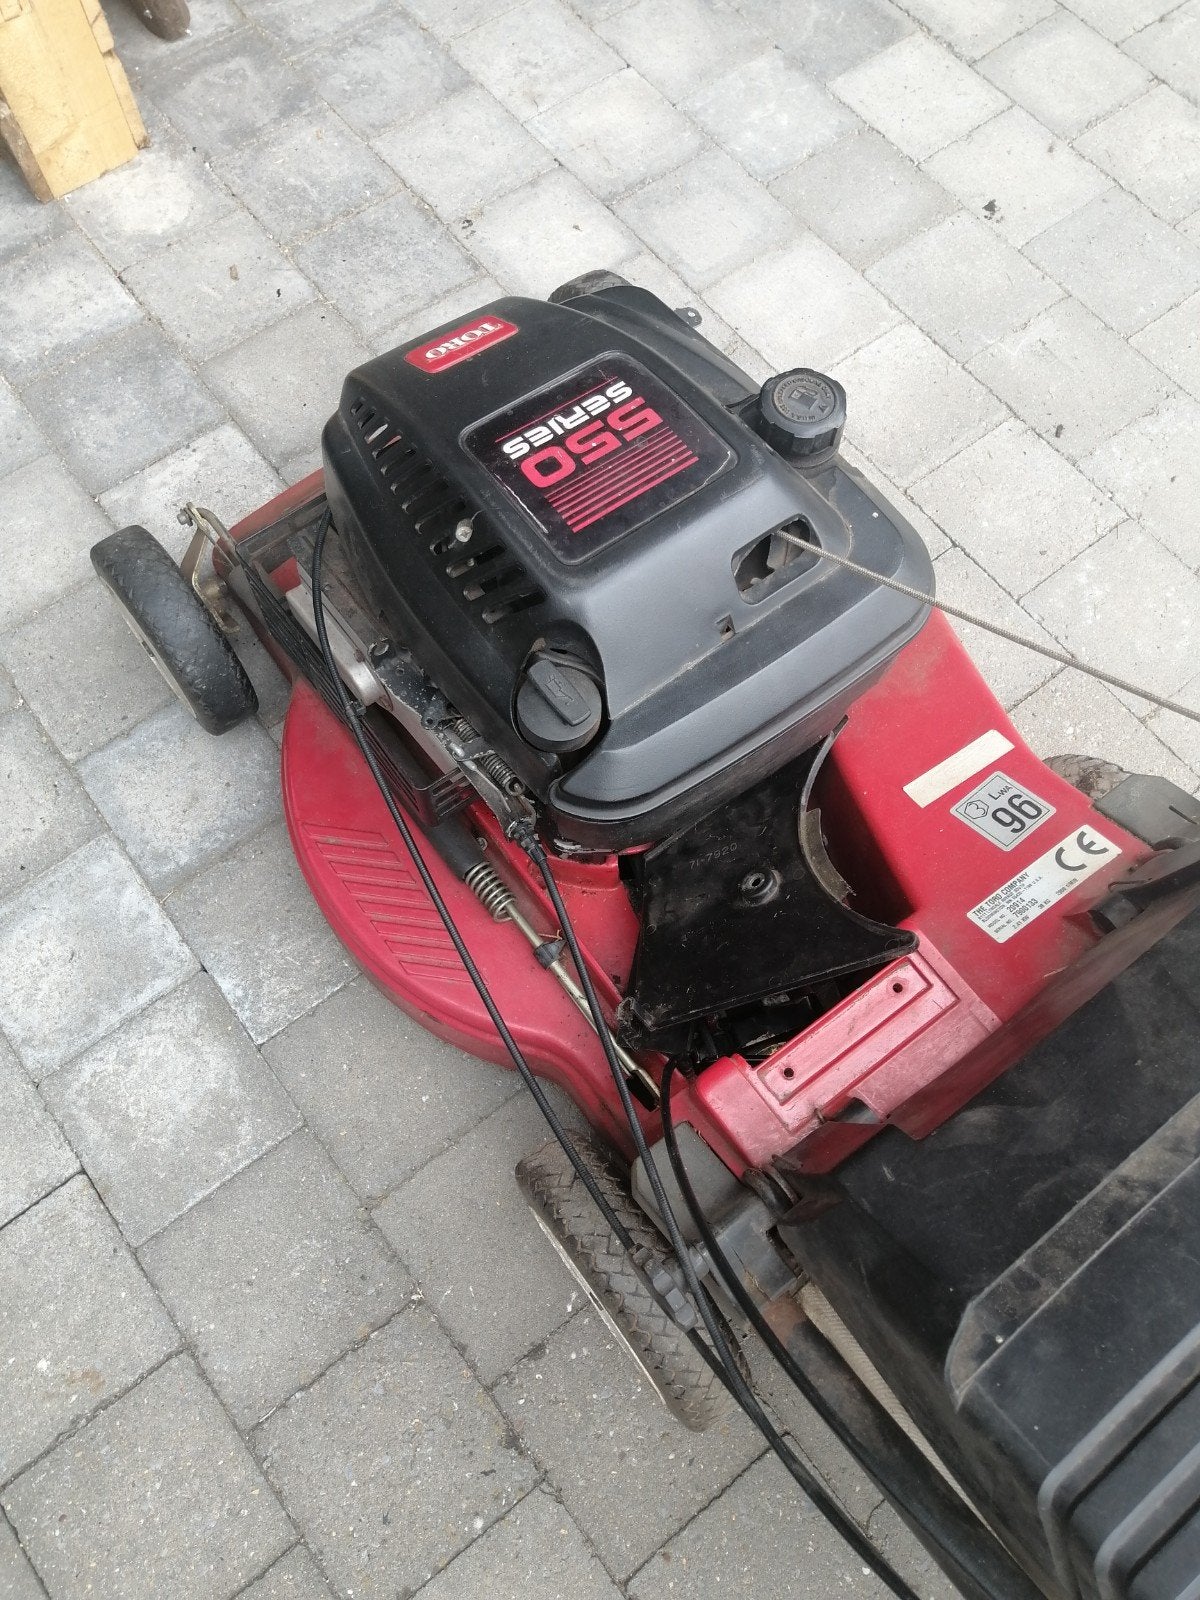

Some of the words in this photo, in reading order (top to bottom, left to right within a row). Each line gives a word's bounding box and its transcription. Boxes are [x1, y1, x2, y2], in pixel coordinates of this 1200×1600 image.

[425, 323, 503, 361] TORO
[503, 381, 633, 460] SERIES
[521, 396, 663, 488] 550
[991, 793, 1043, 834] 96
[1054, 830, 1110, 872] CE
[971, 904, 987, 916] THE
[984, 893, 1002, 907] TORO
[999, 871, 1030, 895] COMPANY
[1005, 896, 1026, 912] 20914
